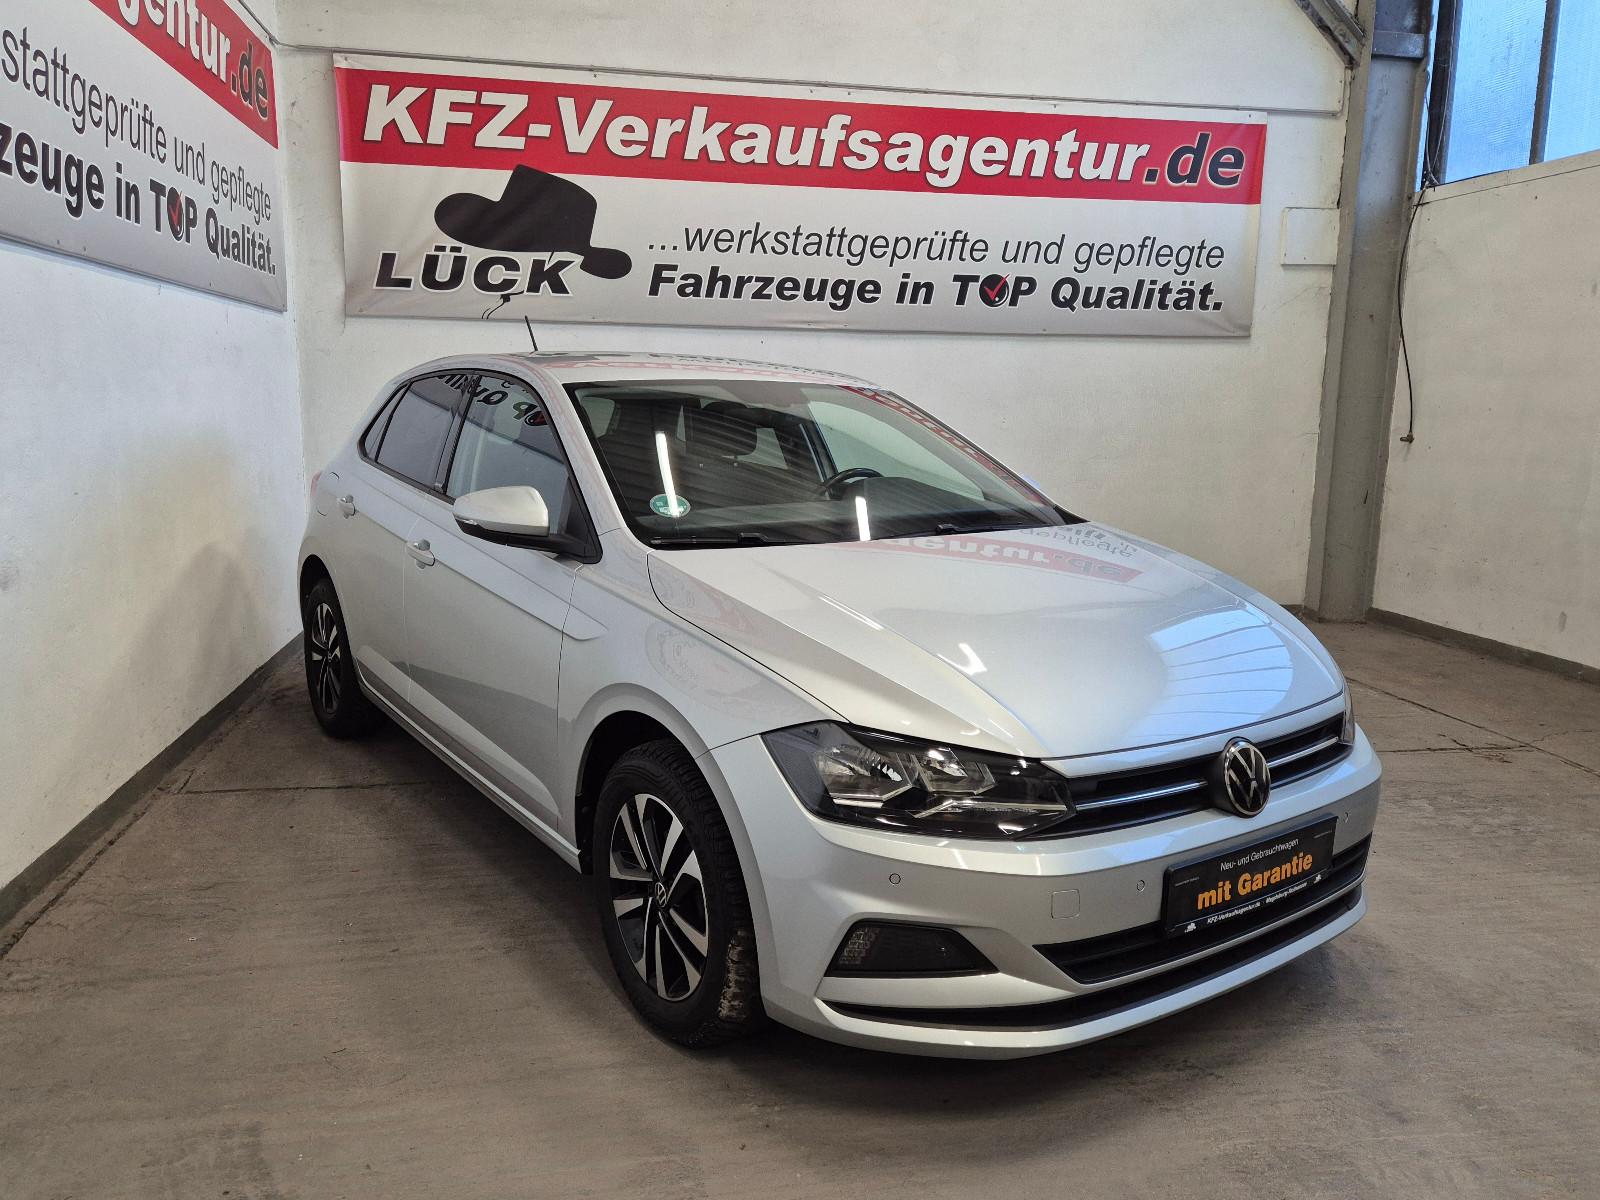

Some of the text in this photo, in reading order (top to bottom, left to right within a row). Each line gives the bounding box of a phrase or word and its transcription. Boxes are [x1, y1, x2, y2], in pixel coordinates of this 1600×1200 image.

[2, 27, 271, 225] stattgeprüfte und gepflegte
[363, 84, 1246, 188] KFZ-Verkaufsagentur.de
[116, 161, 140, 224] in
[150, 178, 197, 243] TOP
[206, 207, 276, 275] Qualität.
[376, 245, 572, 296] LÜCK
[1002, 234, 1065, 264] und
[1074, 236, 1225, 274] gepflegte
[648, 264, 1224, 313] Fahrzeuge in TOP Qualität.
[1197, 880, 1232, 910] mit
[1238, 852, 1313, 896] Garantie
[1237, 854, 1250, 866] und
